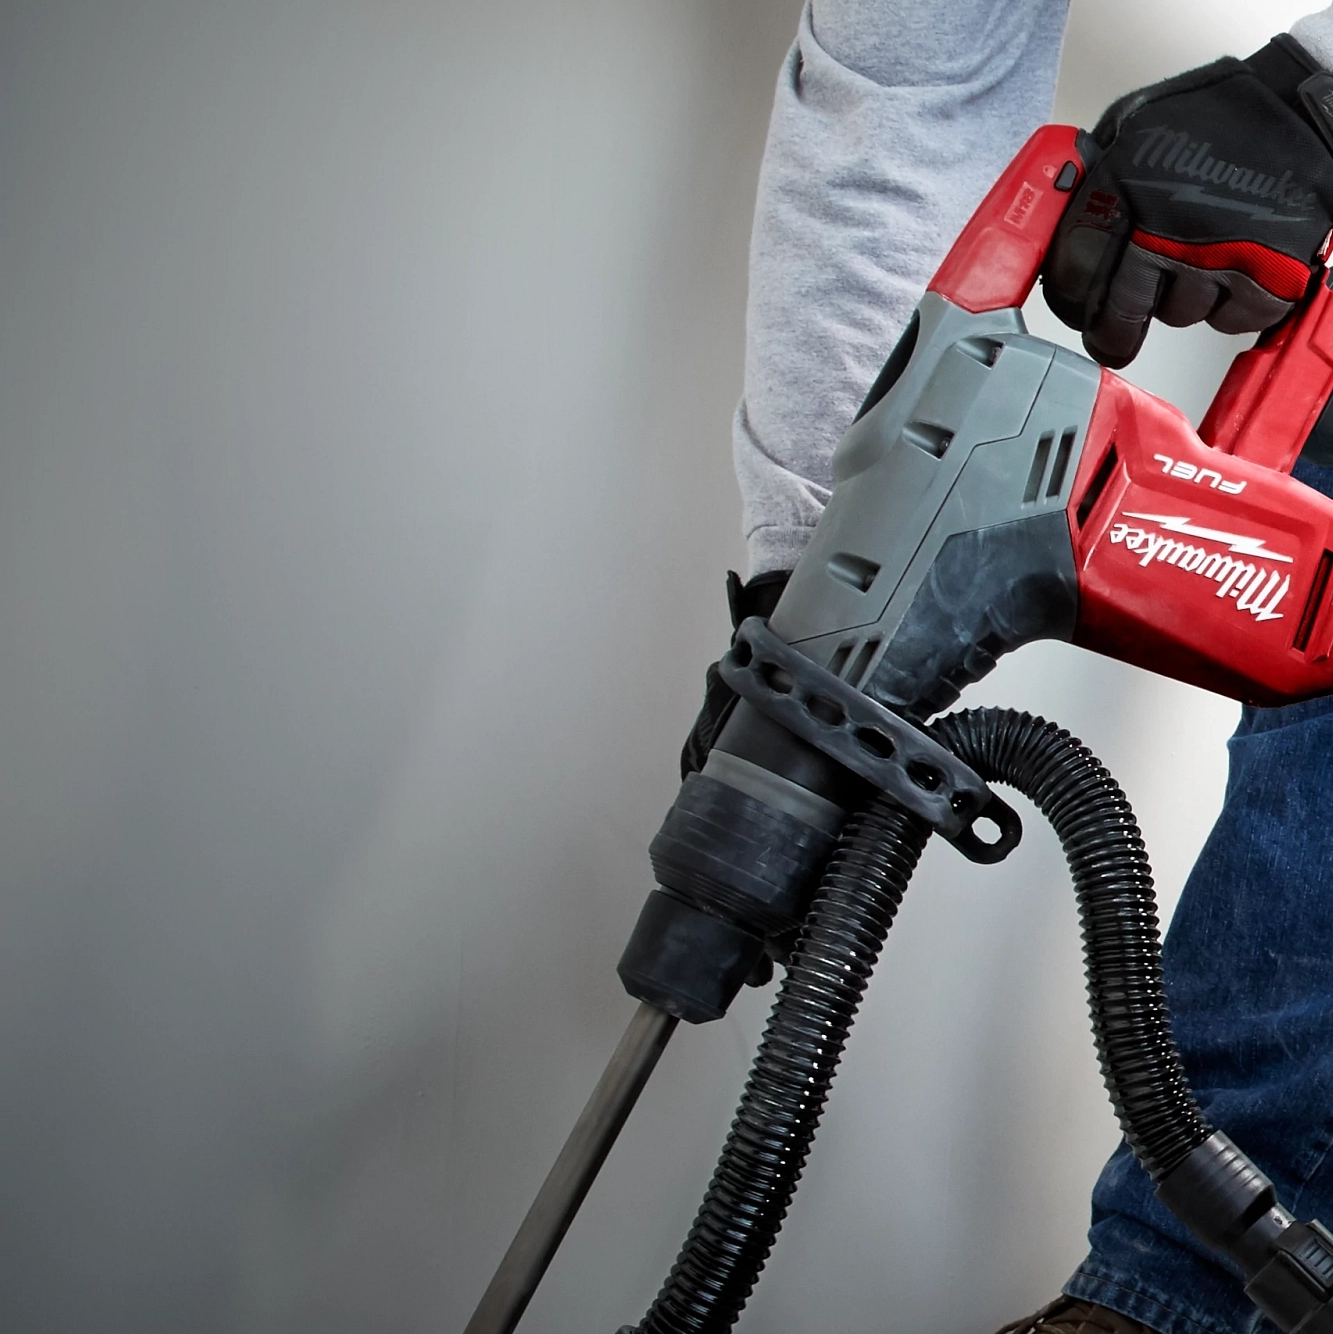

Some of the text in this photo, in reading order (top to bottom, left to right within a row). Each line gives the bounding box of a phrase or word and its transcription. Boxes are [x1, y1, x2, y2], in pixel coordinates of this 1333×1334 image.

[1132, 124, 1317, 211] Milwaukee
[1153, 453, 1248, 496] FUEL
[1109, 523, 1292, 622] Milwaukee
